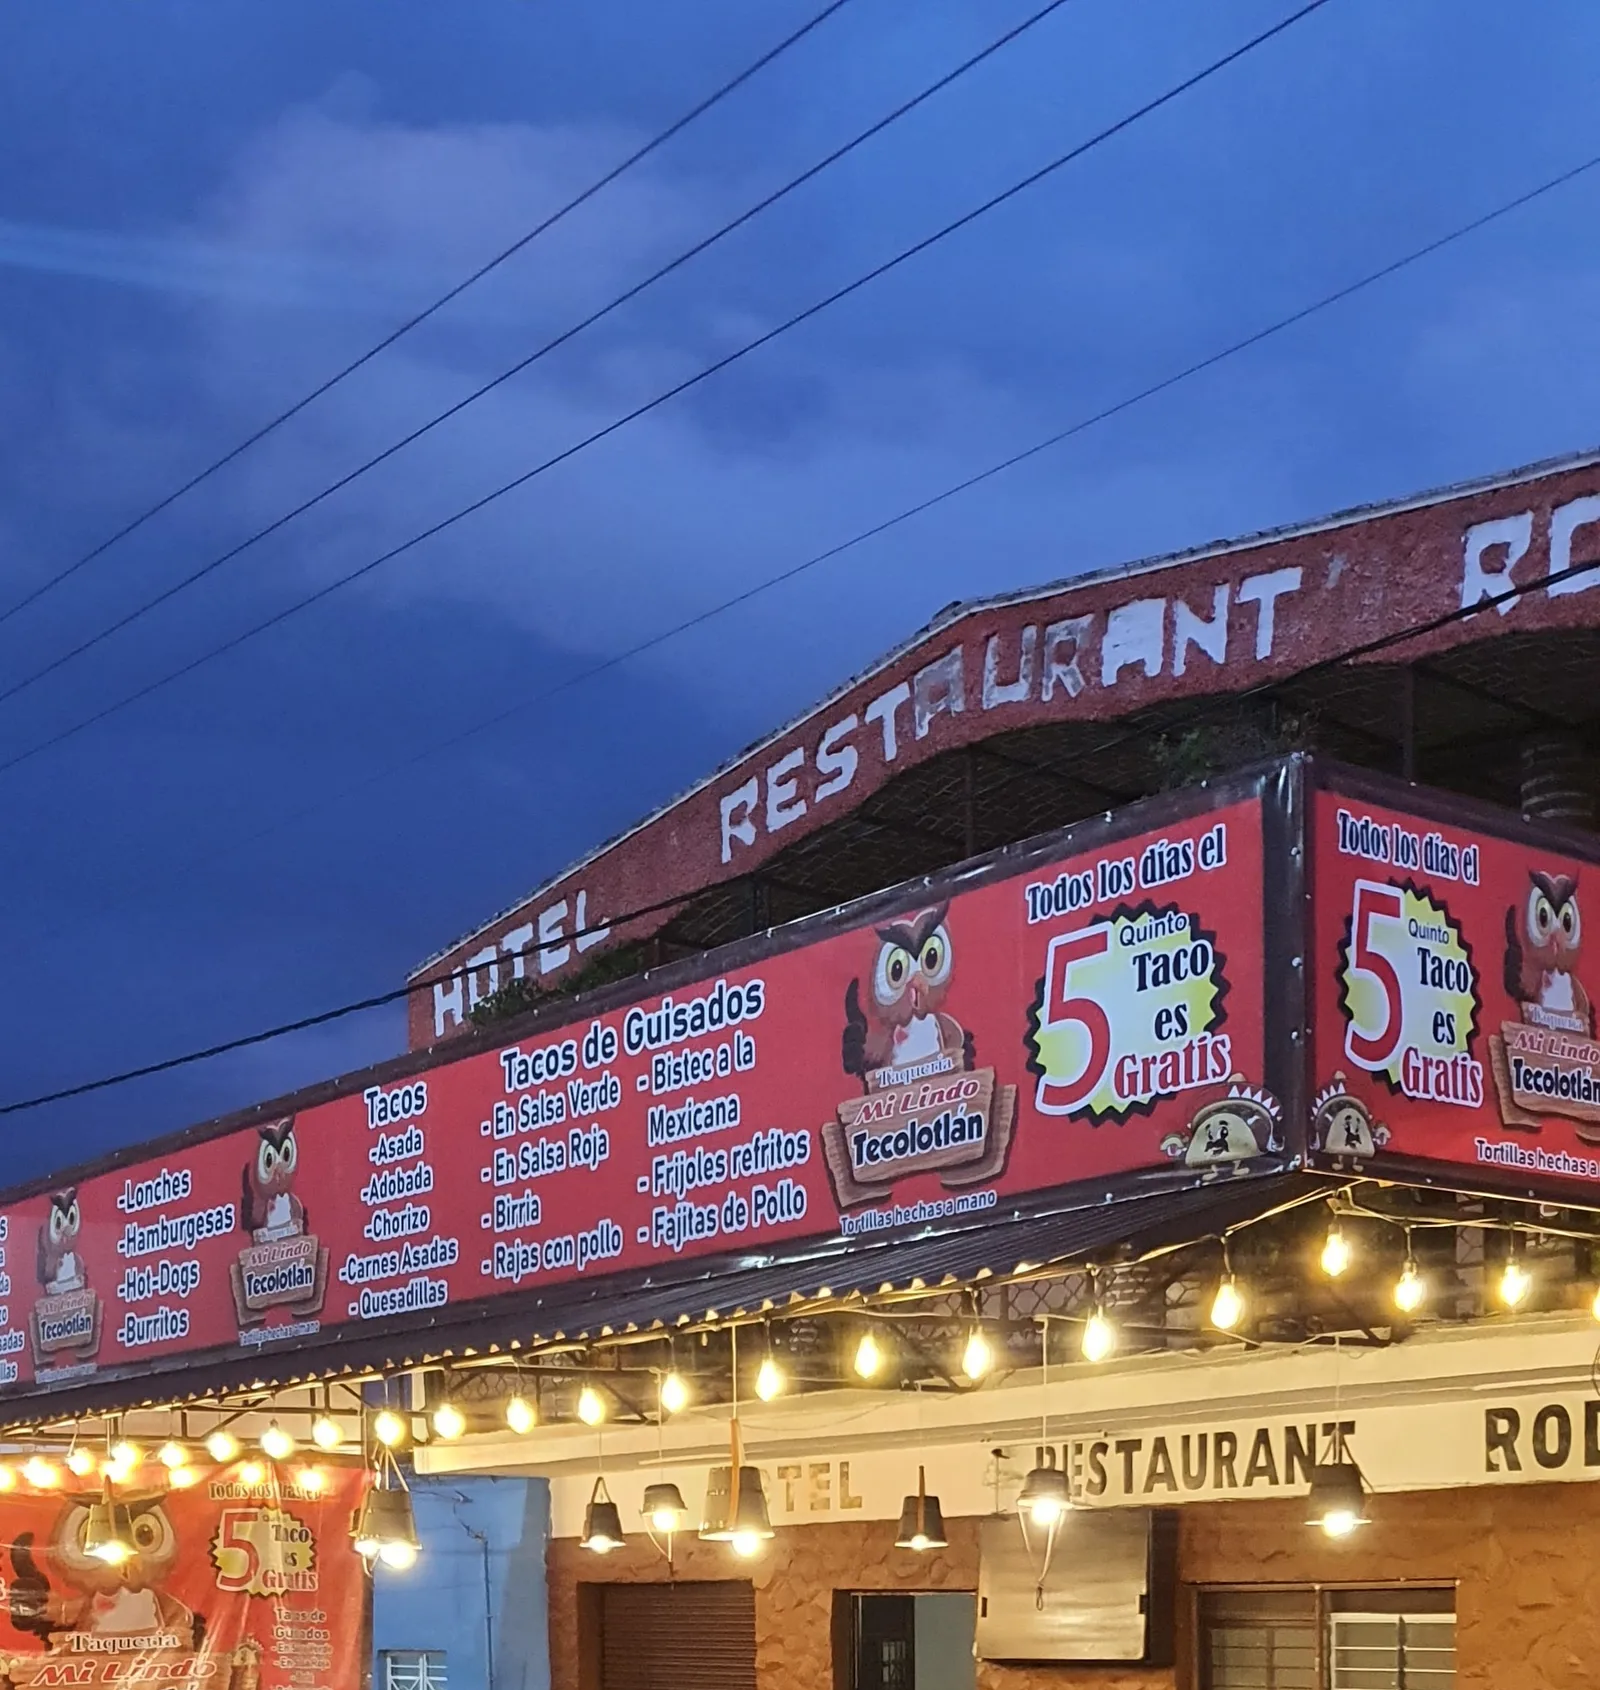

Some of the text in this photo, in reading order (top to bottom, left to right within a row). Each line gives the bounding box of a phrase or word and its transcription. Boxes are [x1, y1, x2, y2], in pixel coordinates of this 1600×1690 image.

[433, 890, 610, 1037] HOTEL
[720, 567, 1302, 863] RESTAURANT
[1339, 812, 1477, 882] Todos los días el
[1028, 827, 1225, 921] Todos los días el
[1119, 913, 1188, 947] Quinto
[1408, 919, 1449, 945] Quinto
[1132, 941, 1211, 991] Taco
[1350, 888, 1401, 1063] 5
[1418, 947, 1469, 993] Taco
[503, 981, 763, 1089] Tacos de Guisados
[1037, 925, 1111, 1113] 5
[1154, 1003, 1188, 1041] es
[1433, 1010, 1455, 1045] es
[654, 1049, 713, 1094] Bistec
[718, 1050, 729, 1073] a
[735, 1033, 755, 1069] la
[1114, 1037, 1231, 1099] Gratis
[1514, 1032, 1600, 1063] Mi Lindo
[1402, 1049, 1482, 1106] Gratis
[365, 1084, 426, 1127] Tacos
[495, 1104, 515, 1137] En
[520, 1091, 565, 1132] Salsa
[569, 1076, 620, 1115] Verde
[648, 1097, 738, 1146] Mexicana
[855, 1081, 979, 1125] Mi Lindo
[495, 1153, 515, 1184] En
[519, 1139, 565, 1179] Salsa
[570, 1126, 608, 1168] Roja
[853, 1106, 982, 1166] Tecolotlán
[1476, 1139, 1597, 1175] Tortillas hechas a
[654, 1149, 728, 1200] Frijoles
[731, 1132, 808, 1171] refritos
[495, 1191, 540, 1231] Birria
[654, 1205, 717, 1252] Fajitas
[723, 1196, 748, 1230] de
[752, 1180, 806, 1223] Pollo
[841, 1192, 996, 1235] Tortillas hechas a mano
[400, 1237, 457, 1270] Asadas
[495, 1242, 538, 1282] Rajas
[544, 1238, 573, 1266] con
[578, 1222, 621, 1270] pollo
[246, 1259, 313, 1296] Tecolotlán
[361, 1280, 446, 1317] Quesadillas
[219, 1511, 259, 1588] 5
[31, 1657, 217, 1685] Mi Lindo
